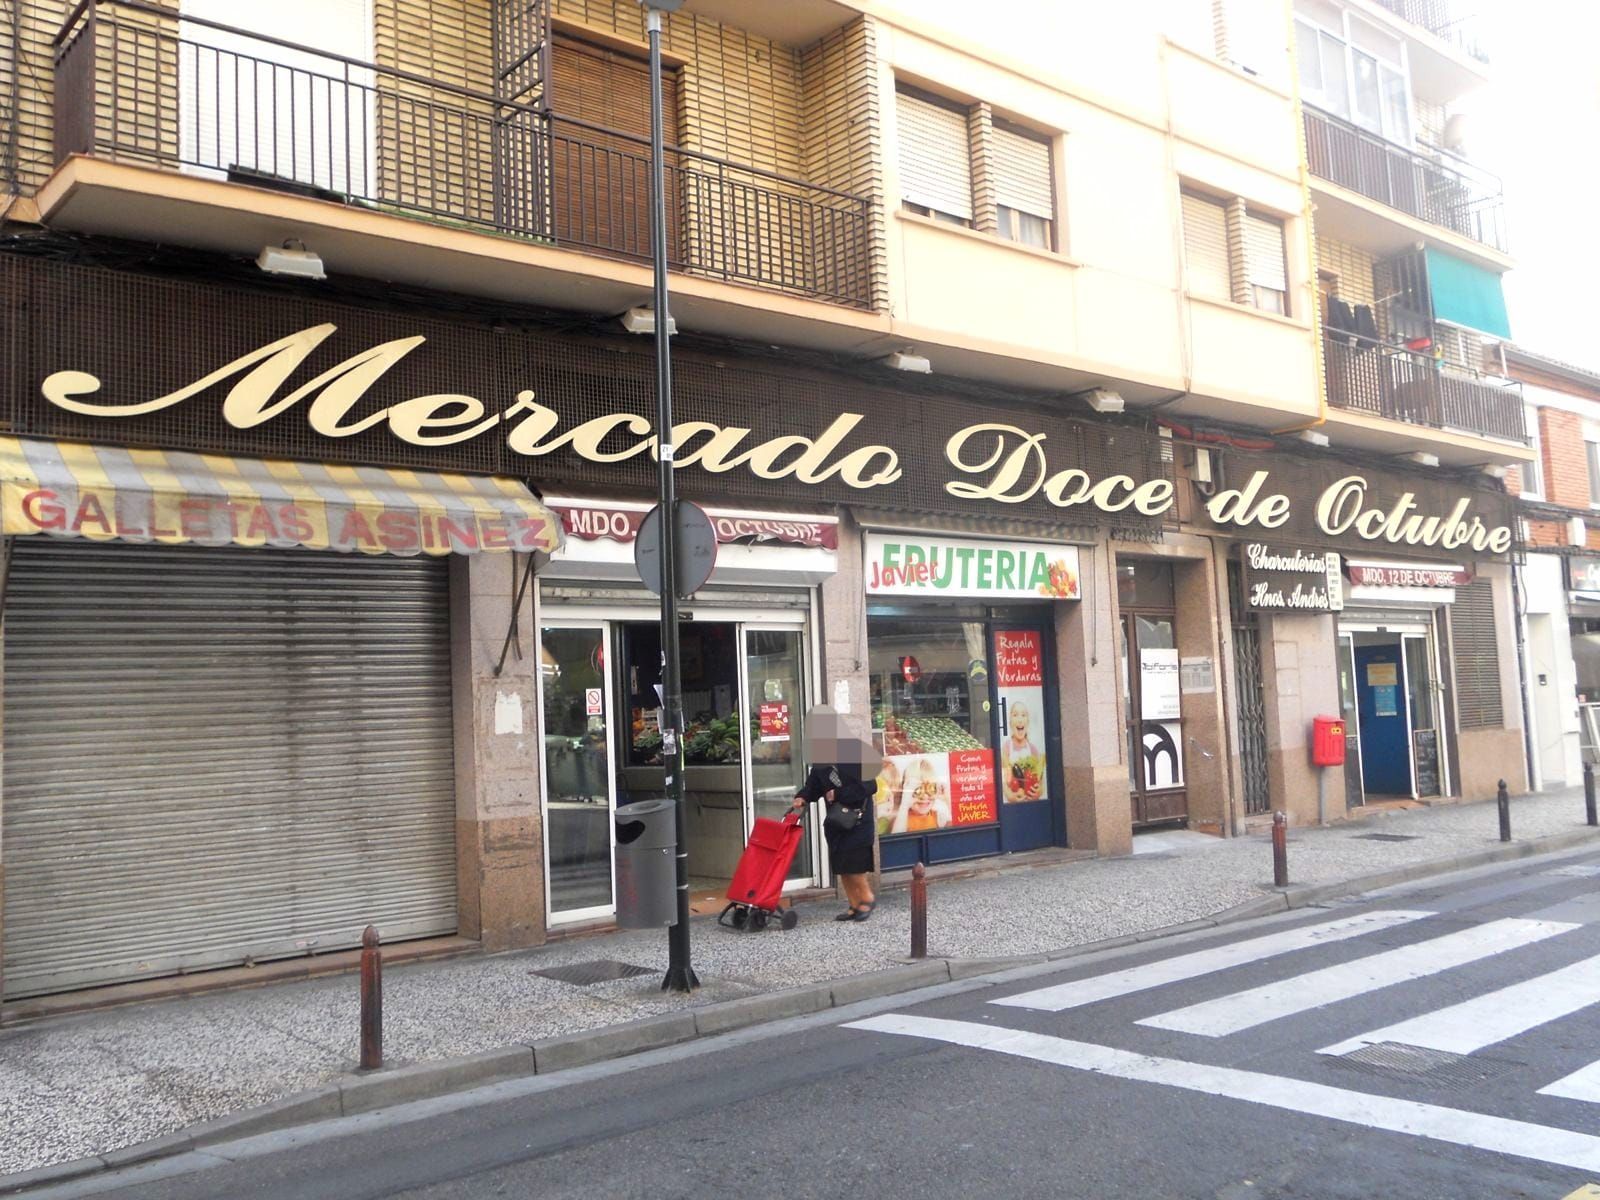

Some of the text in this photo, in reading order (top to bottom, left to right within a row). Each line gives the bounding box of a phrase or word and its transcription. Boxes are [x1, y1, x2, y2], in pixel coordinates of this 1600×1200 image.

[41, 322, 1512, 553] Mercado Doce de Octubre
[22, 489, 550, 550] GALLETAS ASINEZ
[717, 518, 823, 542] OCTUBRE
[870, 556, 939, 589] Javier
[882, 543, 1053, 591] FRUTERIA
[1388, 569, 1399, 584] 12
[1400, 569, 1414, 585] DE
[1414, 570, 1457, 586] OCTUBRE
[1287, 583, 1329, 609] Andrés
[999, 632, 1034, 654] Regala
[996, 651, 1038, 671] Frutas y
[998, 666, 1042, 683] Verduras
[957, 811, 991, 822] JAVIER
